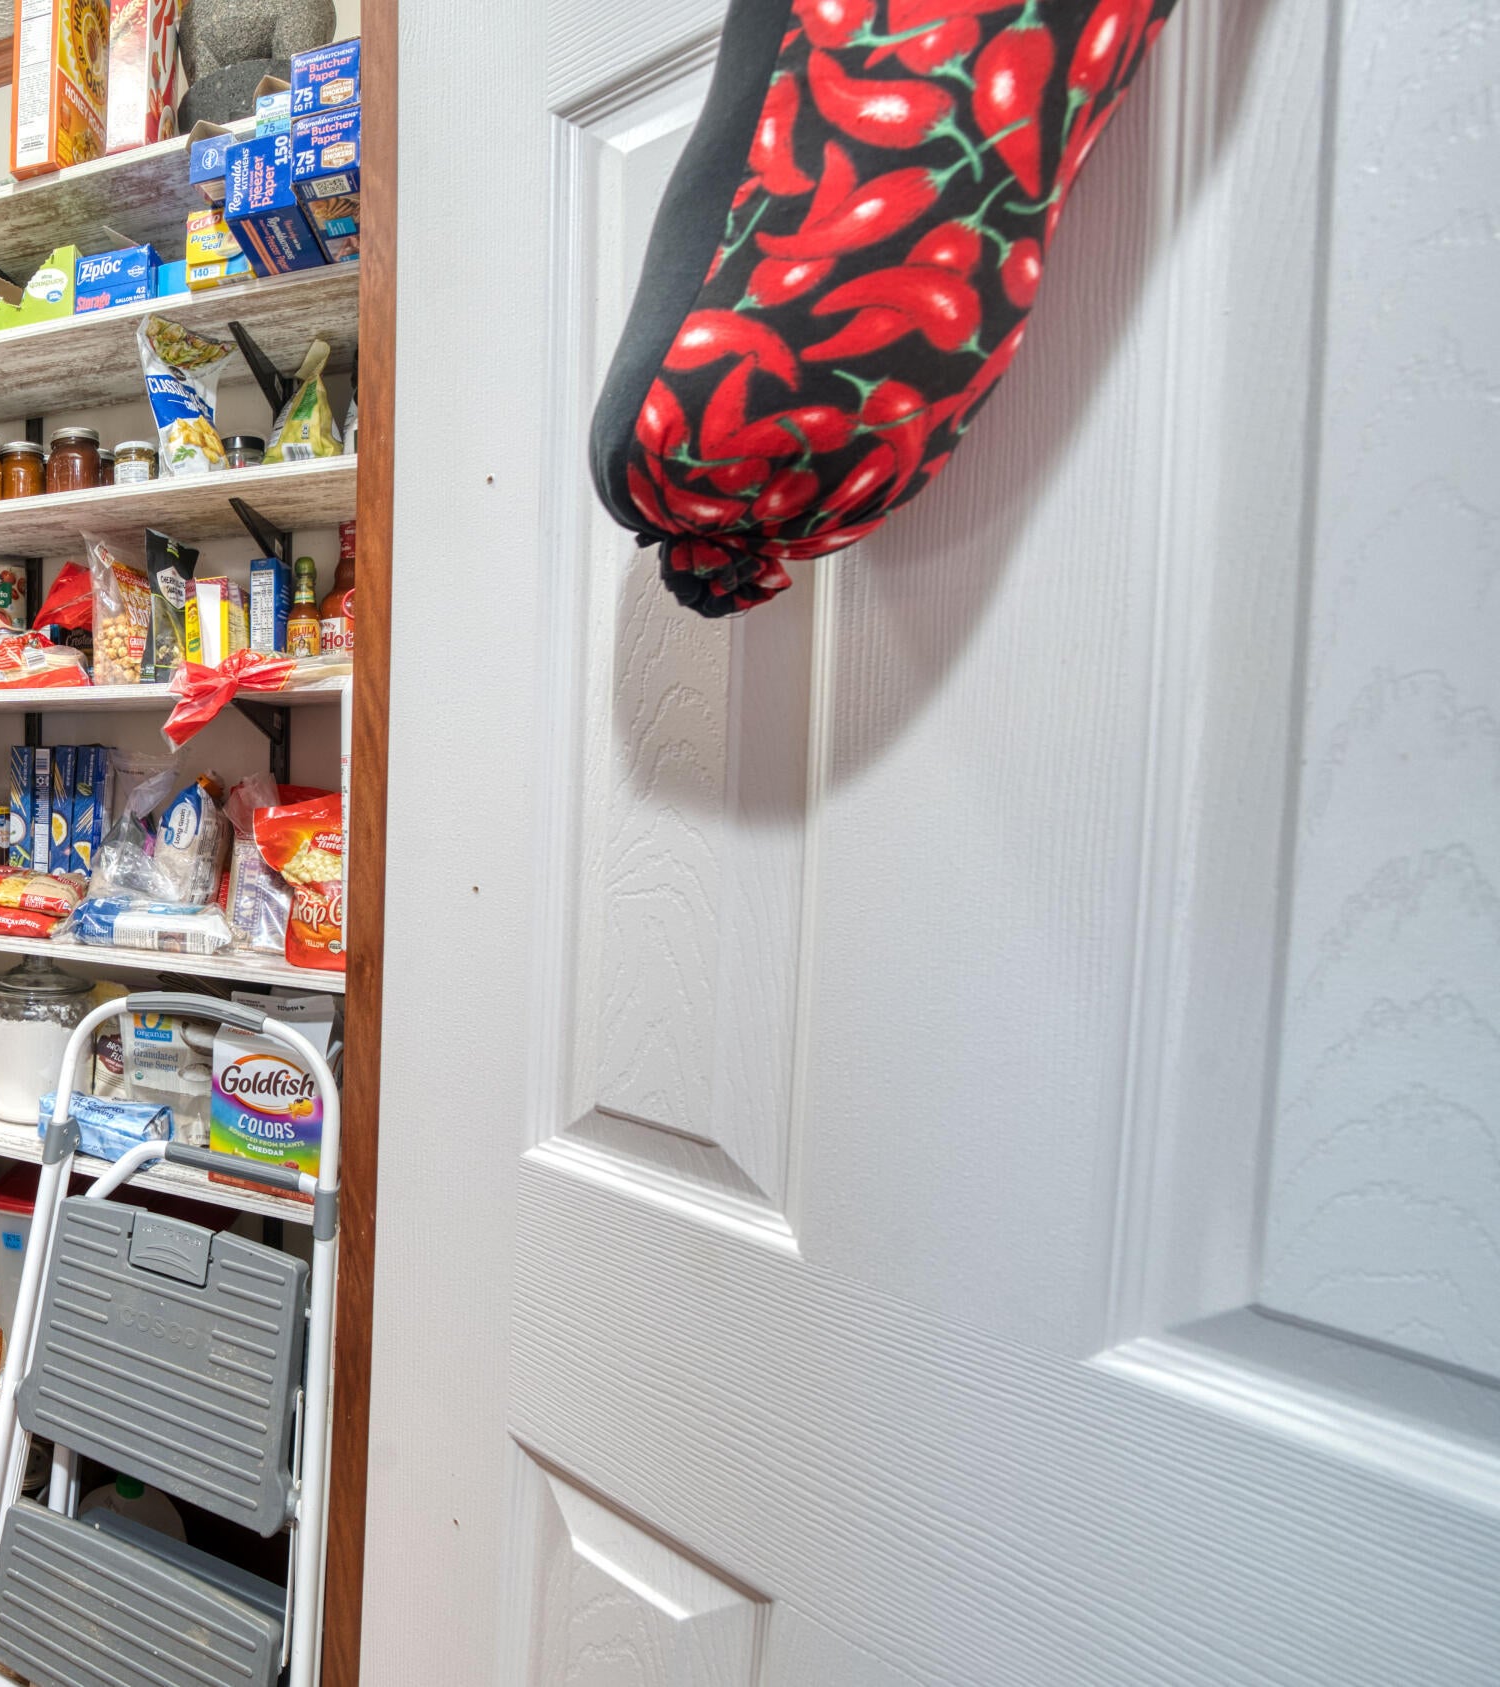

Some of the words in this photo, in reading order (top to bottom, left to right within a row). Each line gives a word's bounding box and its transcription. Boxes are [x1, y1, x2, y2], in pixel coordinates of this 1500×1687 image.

[324, 48, 357, 61] KITCHENS
[309, 56, 351, 73] Butcher
[309, 69, 340, 83] Paper
[294, 87, 313, 104] 75
[322, 85, 351, 98] SMOKERS
[65, 82, 90, 120] HONEY
[294, 103, 303, 113] SQ
[304, 101, 314, 111] FT
[326, 111, 358, 124] KITCHENS
[263, 123, 275, 134] 75
[311, 120, 354, 137] Butcher
[311, 133, 342, 146] Paper
[275, 135, 288, 166] 150
[297, 150, 315, 168] 75
[241, 147, 249, 190] KITCHENS
[296, 168, 305, 176] SQ
[306, 165, 315, 174] FT
[228, 159, 244, 213] Reynolds
[250, 156, 264, 209] Freezer
[262, 165, 278, 207] Paper
[190, 213, 220, 231] GLAD
[201, 239, 222, 251] Seal
[80, 259, 122, 282] Ziploc
[193, 267, 209, 277] 140
[135, 286, 146, 294] 42
[75, 291, 112, 312] Storage
[115, 296, 133, 304] GALLON
[177, 808, 187, 827] Grain
[173, 827, 182, 845] Long
[315, 833, 342, 844] Jolly
[317, 841, 342, 850] Time
[296, 890, 327, 933] Pop
[304, 938, 325, 949] YELLOW
[136, 1030, 171, 1040] organics
[134, 1048, 179, 1062] Granulated
[134, 1058, 154, 1068] Cane
[155, 1060, 177, 1073] Sugar
[219, 1063, 316, 1099] Goldfish
[85, 1106, 115, 1120] Serving
[237, 1112, 297, 1141] COLORS
[228, 1126, 259, 1145] SOURCED
[258, 1138, 279, 1148] FROM
[279, 1140, 306, 1150] PLANTS
[246, 1142, 285, 1157] CHEDDAR
[121, 1304, 198, 1351] COSCO
